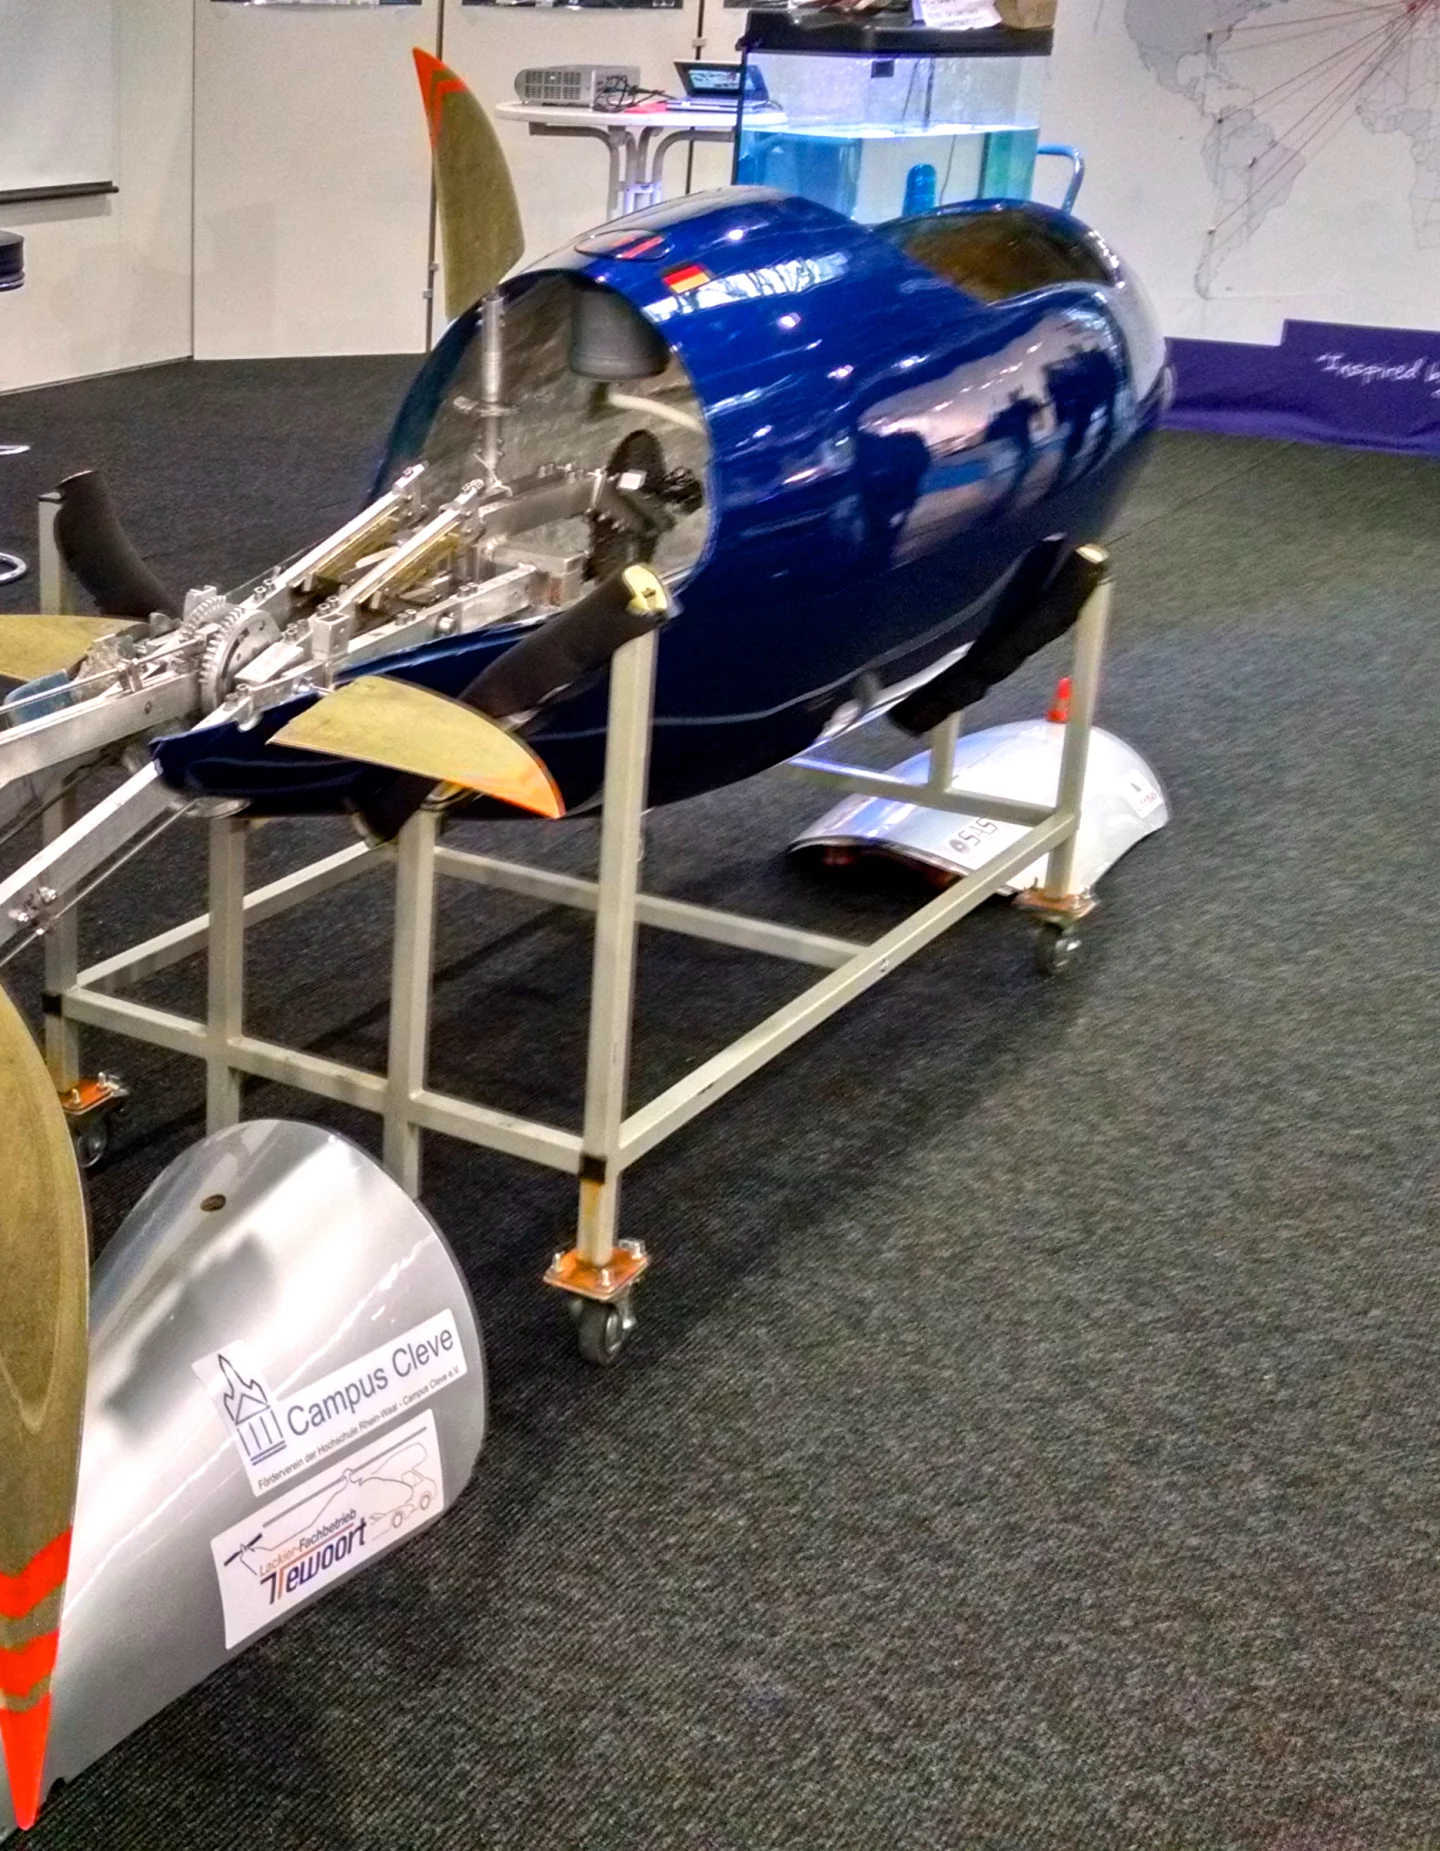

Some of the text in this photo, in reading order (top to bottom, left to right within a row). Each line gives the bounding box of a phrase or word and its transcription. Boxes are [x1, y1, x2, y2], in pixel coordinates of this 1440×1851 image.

[287, 1329, 454, 1436] Campus Cleve
[304, 1450, 317, 1463] der
[402, 1385, 430, 1405] Campus
